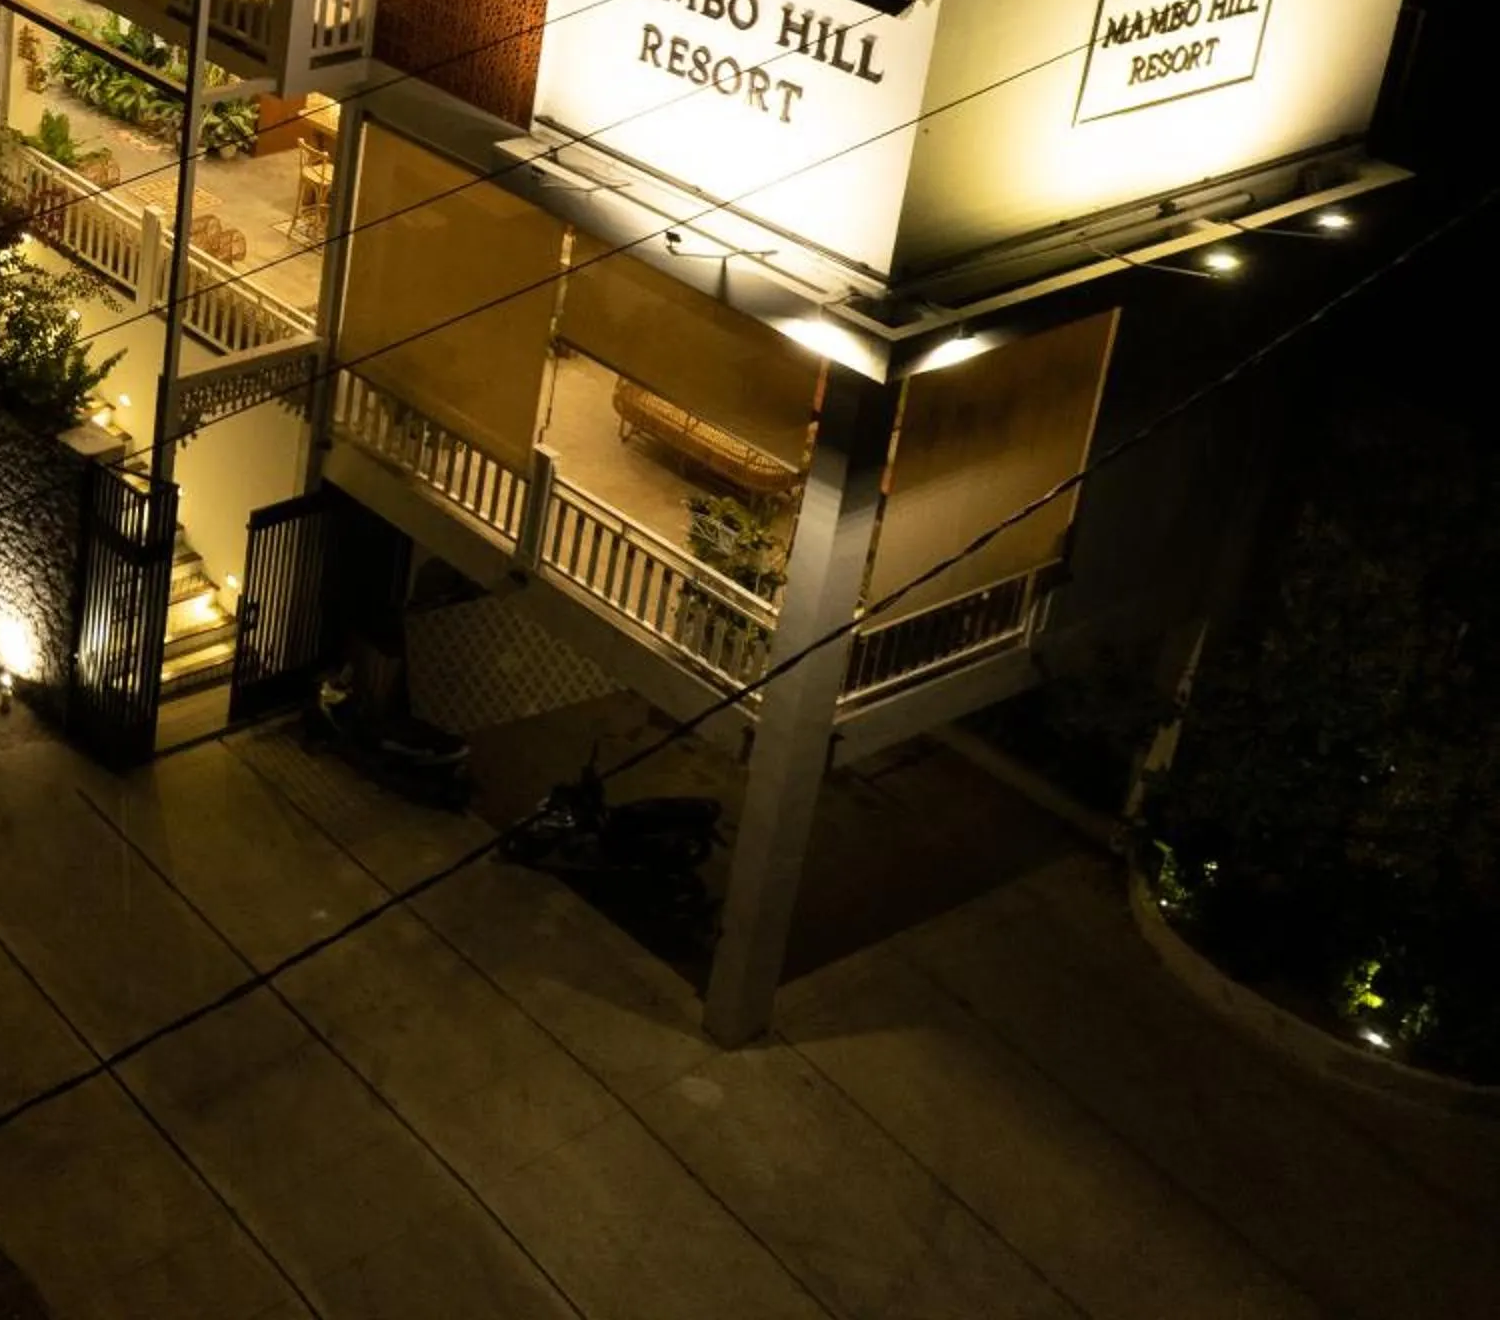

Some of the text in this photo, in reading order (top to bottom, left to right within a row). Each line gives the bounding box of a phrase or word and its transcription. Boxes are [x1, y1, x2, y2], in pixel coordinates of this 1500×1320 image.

[638, 24, 803, 123] RESORT
[775, 2, 884, 84] HILL
[1128, 37, 1220, 86] RESORT
